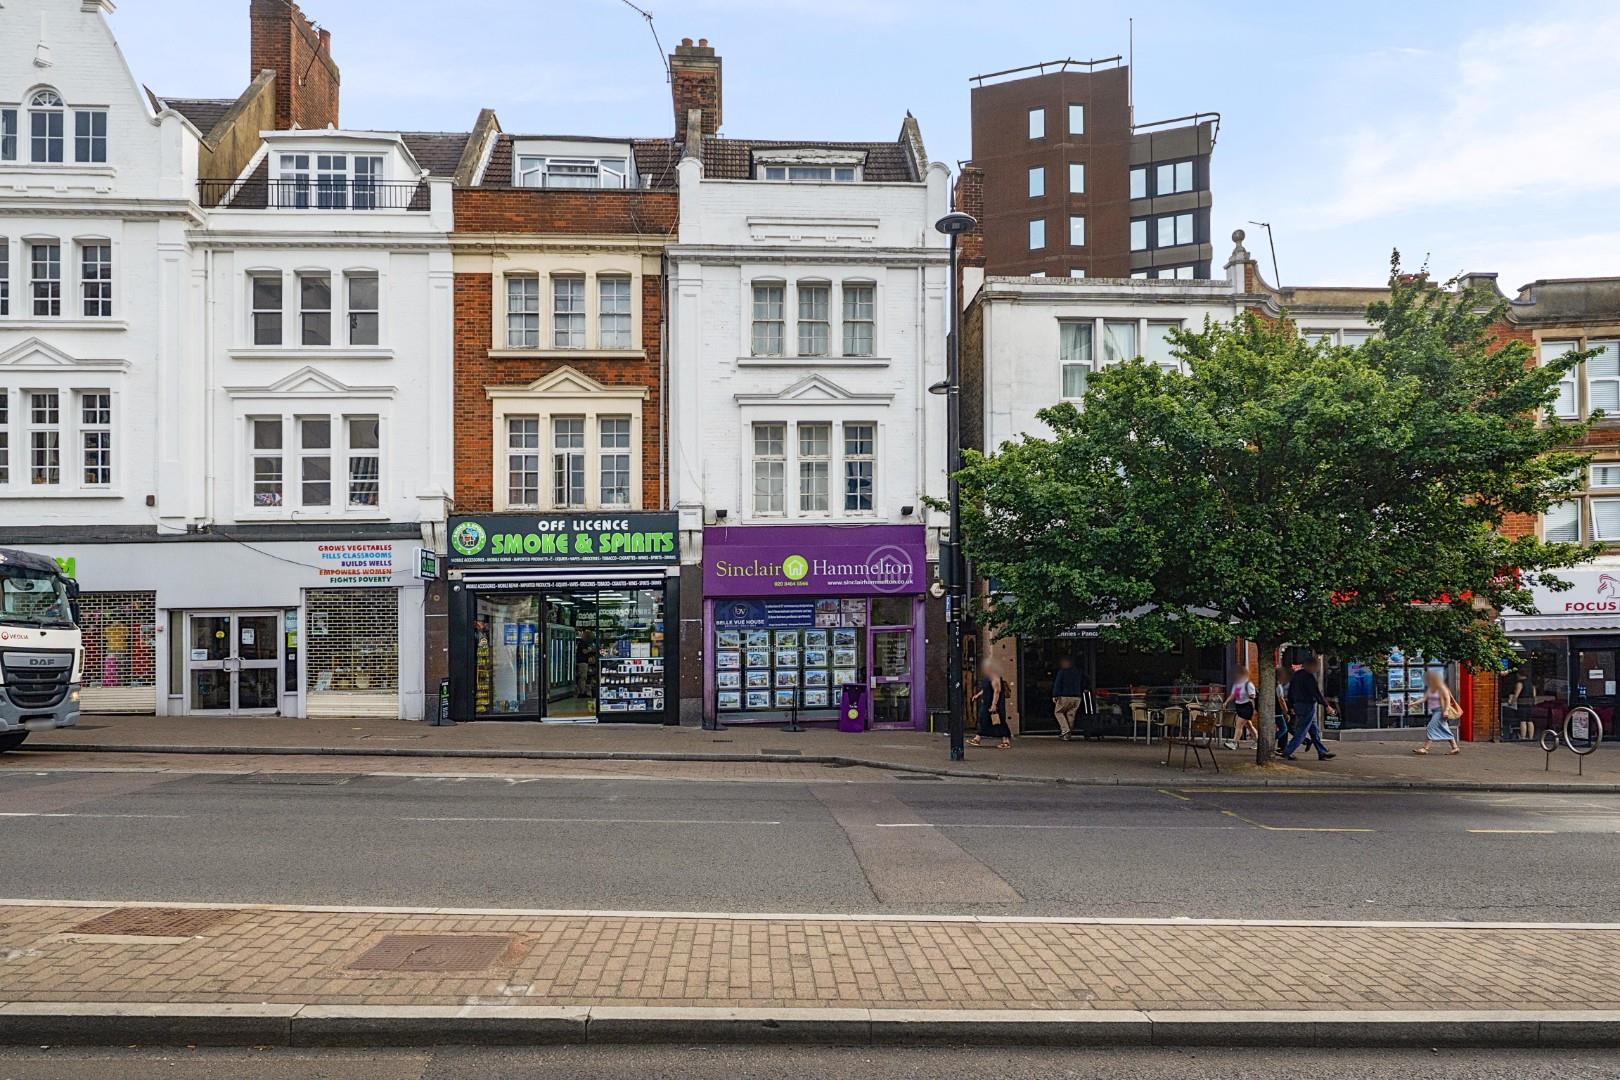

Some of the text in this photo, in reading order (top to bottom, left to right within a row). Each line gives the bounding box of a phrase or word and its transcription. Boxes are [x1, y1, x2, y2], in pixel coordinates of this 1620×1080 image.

[538, 519, 629, 532] OFF LICENCE
[491, 532, 675, 554] SMOKE & SPIRITS
[716, 558, 913, 578] Sinclair Hammelton
[1565, 602, 1616, 612] FOCUS
[29, 658, 55, 667] DAF
